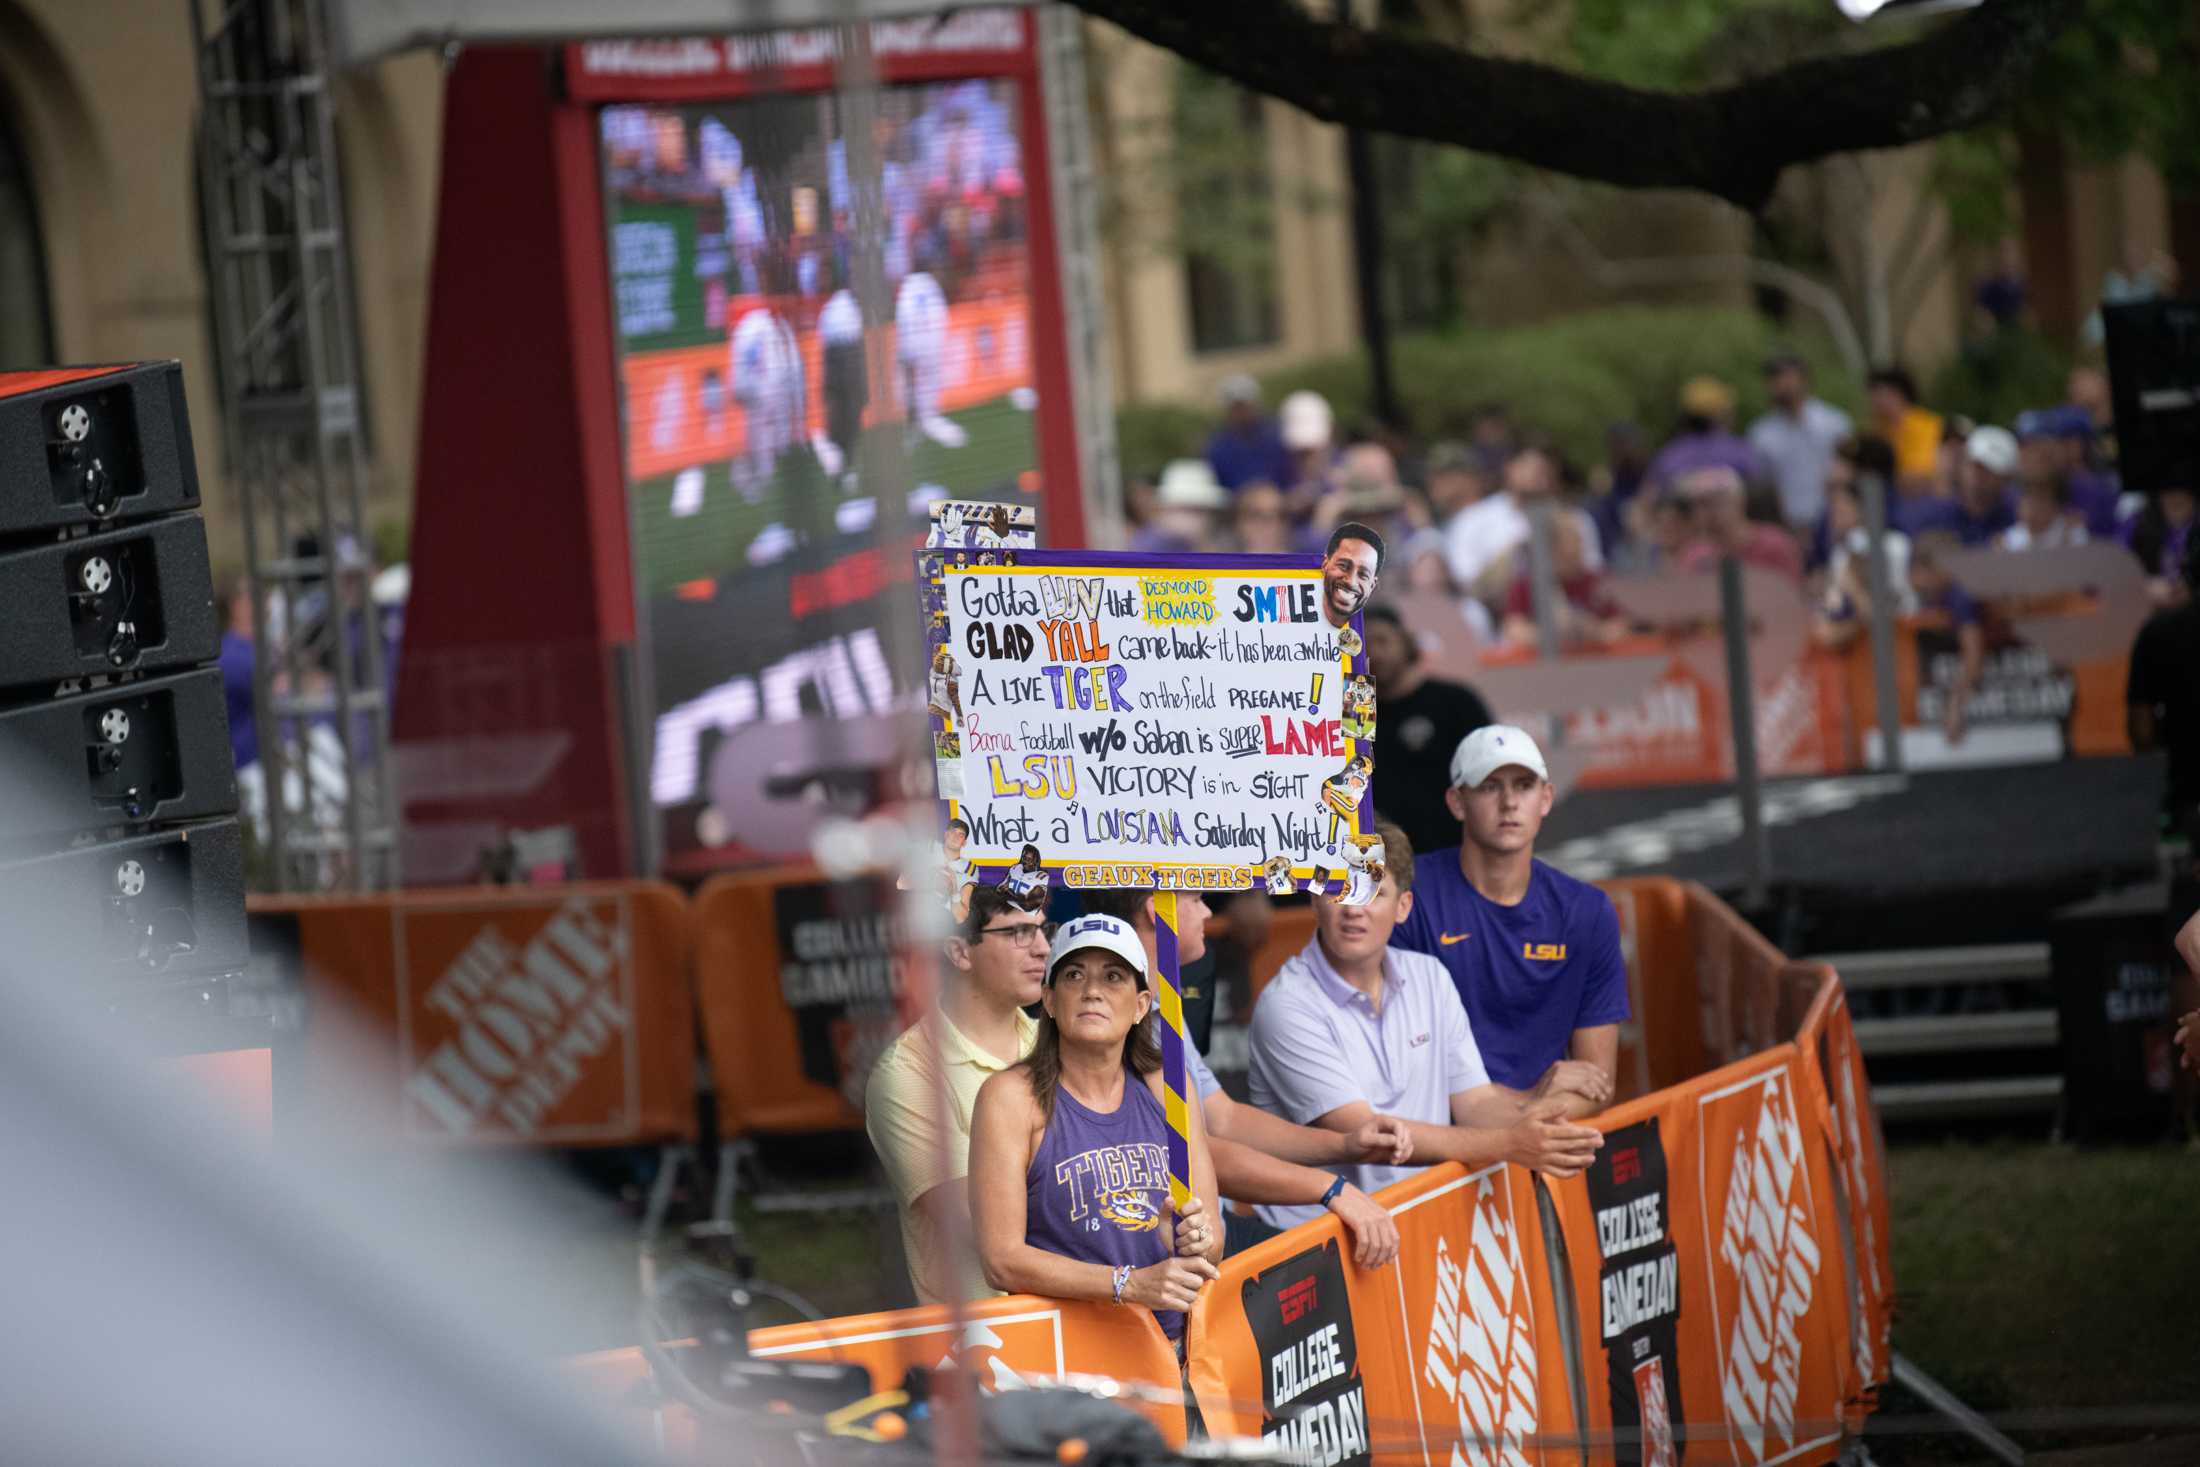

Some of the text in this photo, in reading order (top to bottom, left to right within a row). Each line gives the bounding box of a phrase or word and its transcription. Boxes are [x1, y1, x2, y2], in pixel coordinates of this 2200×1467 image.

[961, 575, 1319, 623] Gotta LUV that DESMOND HOWARD SMILE
[966, 621, 1034, 663] GLAD
[1037, 619, 1110, 663] YALL
[1118, 635, 1171, 660] came
[1235, 630, 1259, 663] has
[1259, 628, 1292, 663] been
[970, 668, 997, 706] A
[1001, 677, 1046, 704] LIVE
[1041, 663, 1134, 713] TIGER
[1181, 676, 1216, 711] field
[966, 713, 1346, 762] Bama football w/o Saban is SUPER LAME
[986, 754, 1077, 800] LSU
[1086, 765, 1196, 799] VICTORY
[1202, 775, 1217, 794] is
[1219, 773, 1242, 795] in
[959, 802, 1040, 849] What
[1051, 817, 1070, 843] a
[1194, 811, 1267, 865] Saturday
[1065, 866, 1253, 888] GEAUX TIGERS
[1069, 920, 1120, 938] LSU
[1523, 943, 1567, 960] LSU
[1056, 1143, 1170, 1222] TIGER
[1720, 1127, 1752, 1280] THE
[1597, 1192, 1664, 1259] COLLEGE
[1602, 1252, 1677, 1338] GAMEDAY
[1725, 1075, 1801, 1465] HOME
[1277, 1274, 1317, 1326] ESPN
[1424, 1235, 1461, 1403] THE
[1769, 1204, 1821, 1450] DEPOT
[1272, 1323, 1346, 1409] COLLEGE
